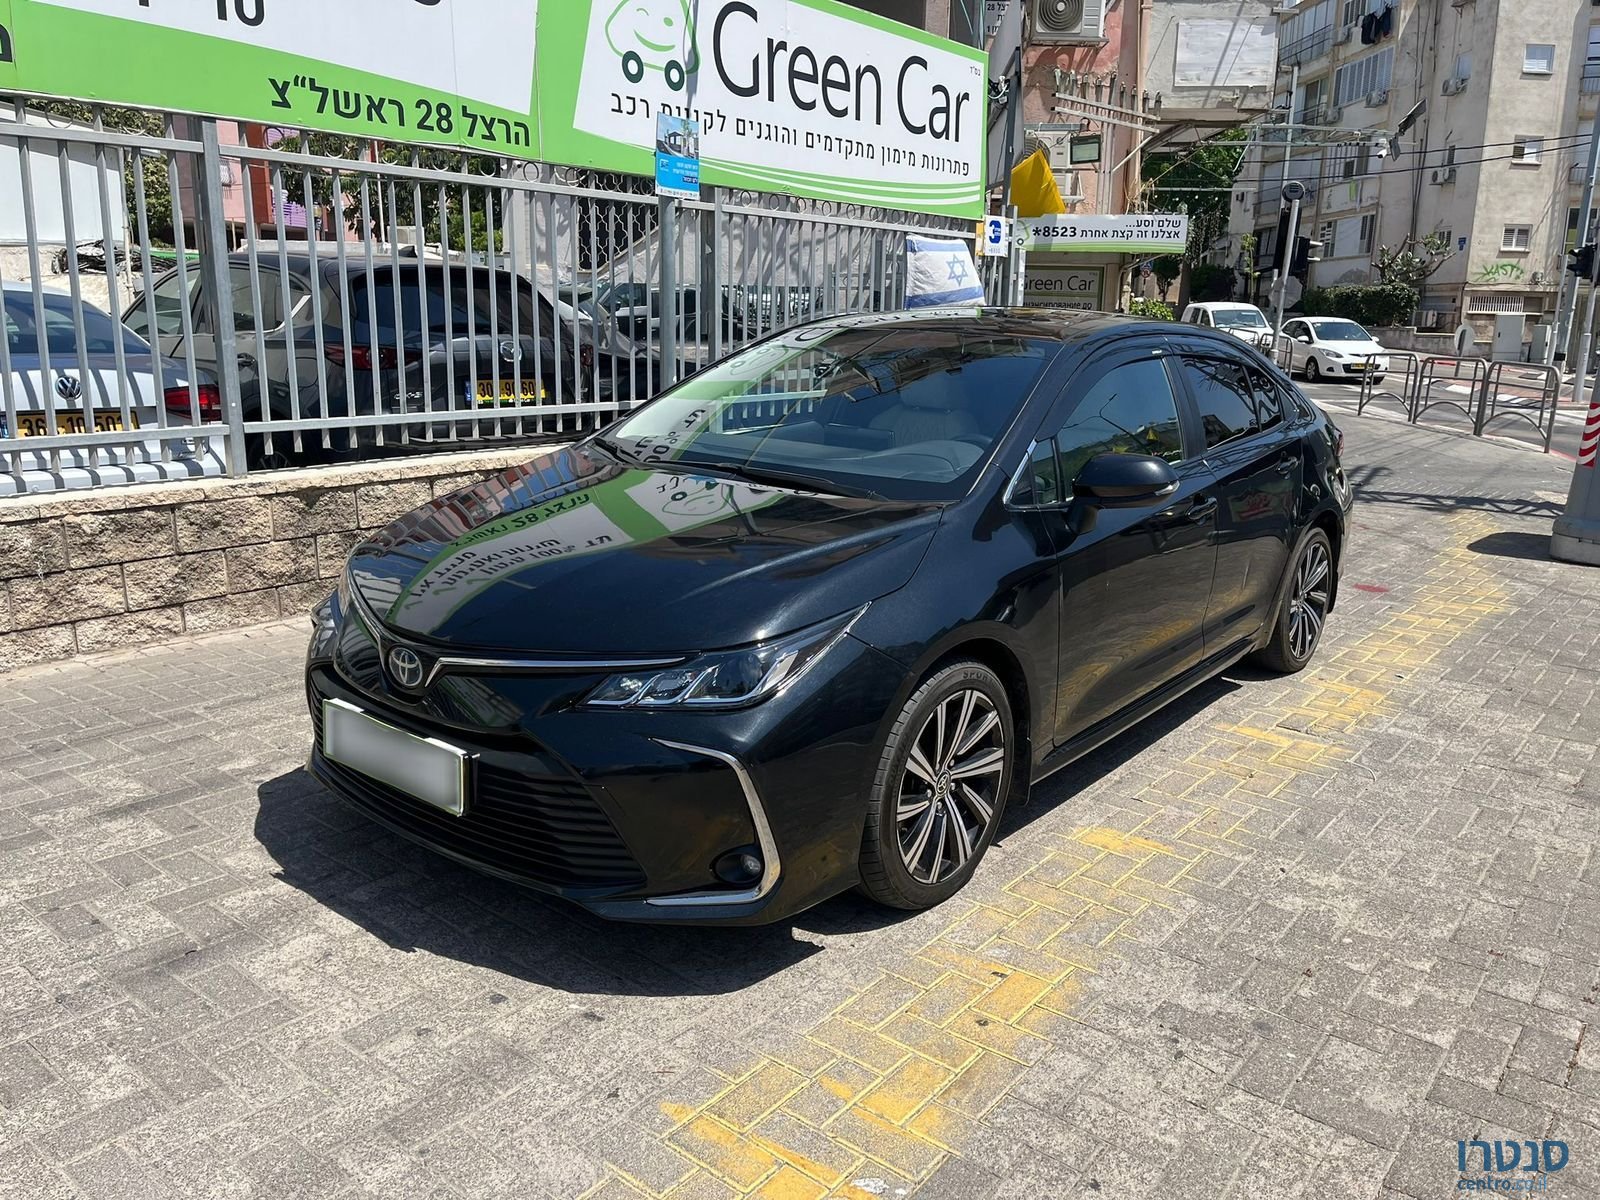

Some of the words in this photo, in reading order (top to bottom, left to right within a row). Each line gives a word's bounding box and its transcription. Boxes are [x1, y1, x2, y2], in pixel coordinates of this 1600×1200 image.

[712, 1, 882, 125] Green
[897, 55, 970, 142] Car
[415, 99, 454, 134] 28
[611, 93, 649, 119] רכב
[461, 105, 530, 147] הרצל
[736, 117, 797, 147] והוגנים
[805, 131, 875, 160] מתקדמים
[881, 145, 916, 167] מימון
[921, 152, 969, 177] פתרונות
[1080, 230, 1109, 238] אחרת
[1136, 230, 1149, 238] זה
[1151, 229, 1180, 239] אצלנו
[1158, 218, 1181, 228] שלם
[1111, 230, 1133, 240] קצת
[1067, 275, 1095, 291] Car
